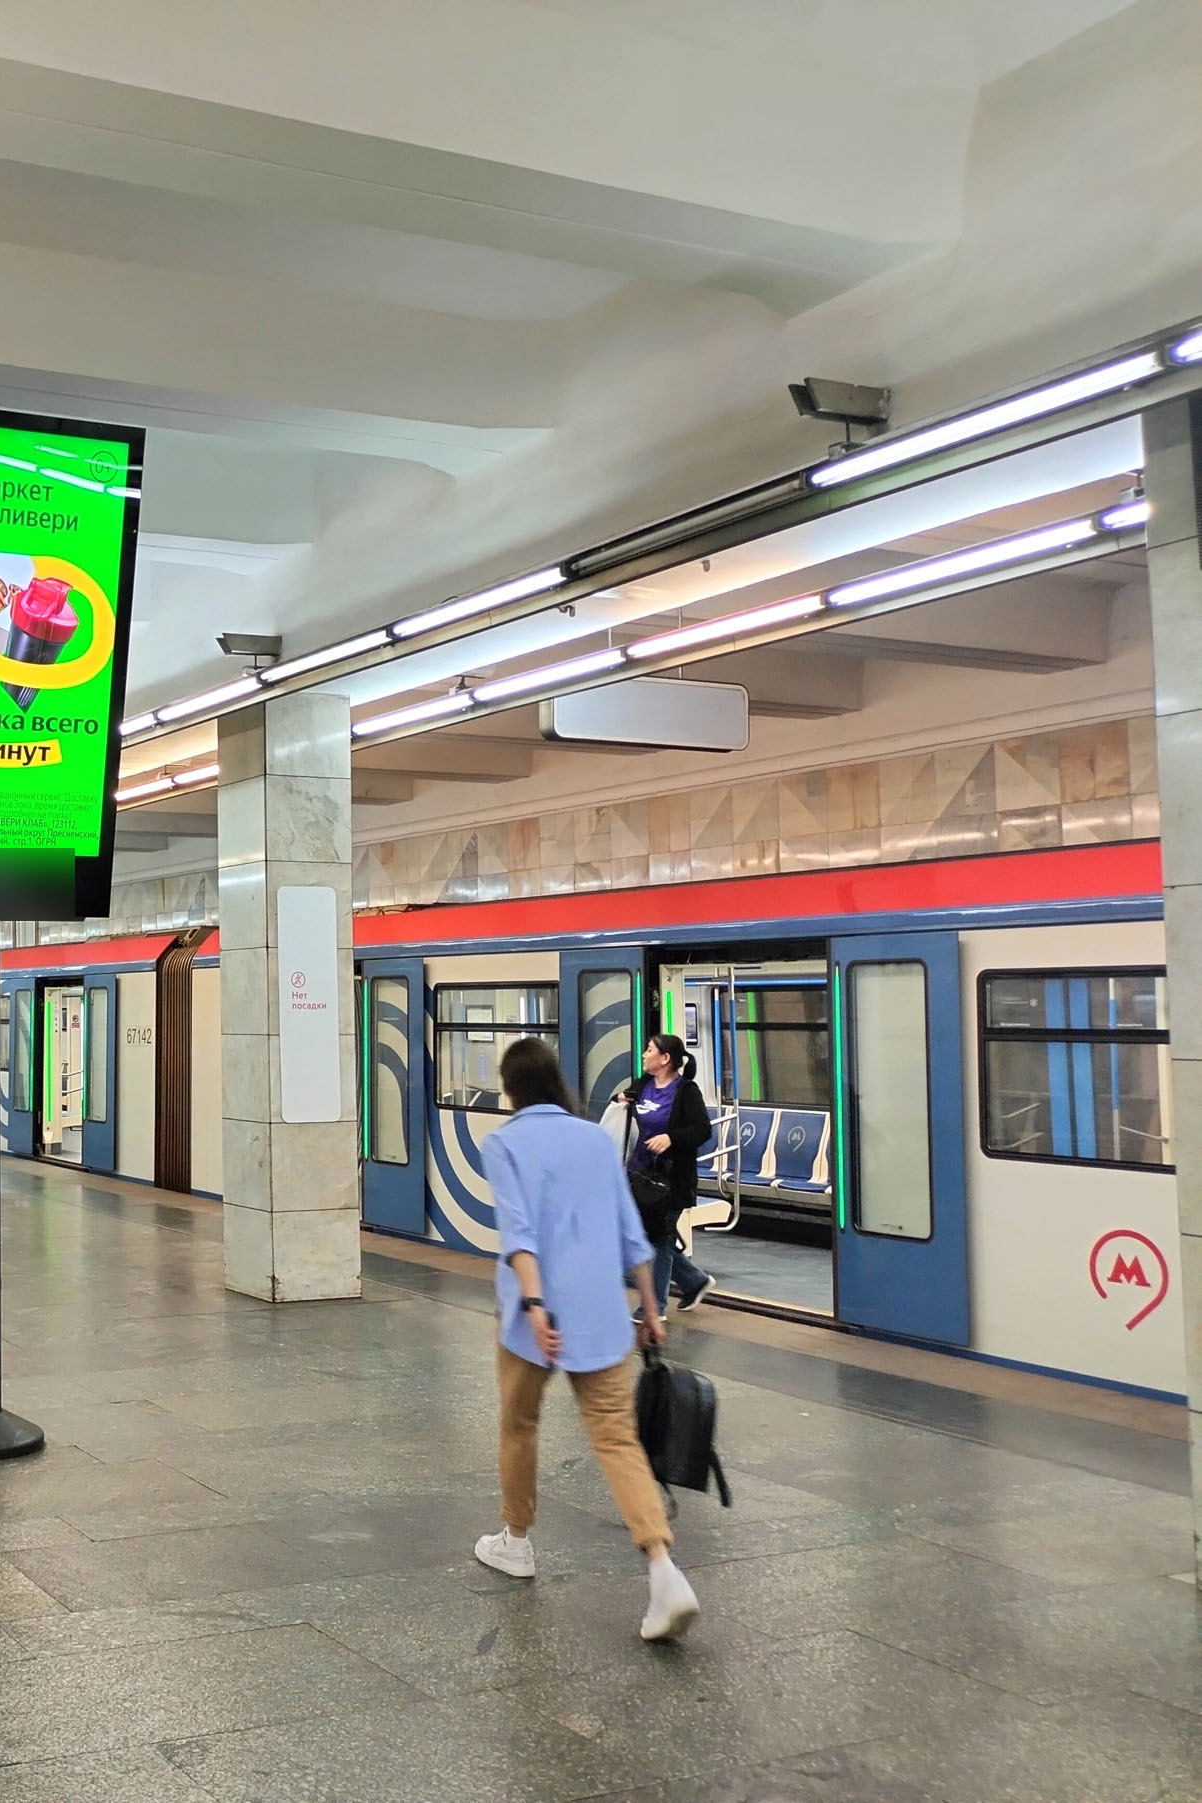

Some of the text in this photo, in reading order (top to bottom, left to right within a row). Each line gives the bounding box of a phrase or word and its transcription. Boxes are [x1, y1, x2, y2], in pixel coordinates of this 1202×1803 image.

[31, 715, 99, 735] всего
[24, 829, 46, 839] округ
[291, 991, 307, 1000] Нет
[292, 1003, 327, 1011] посадки
[126, 1028, 152, 1044] 67142
